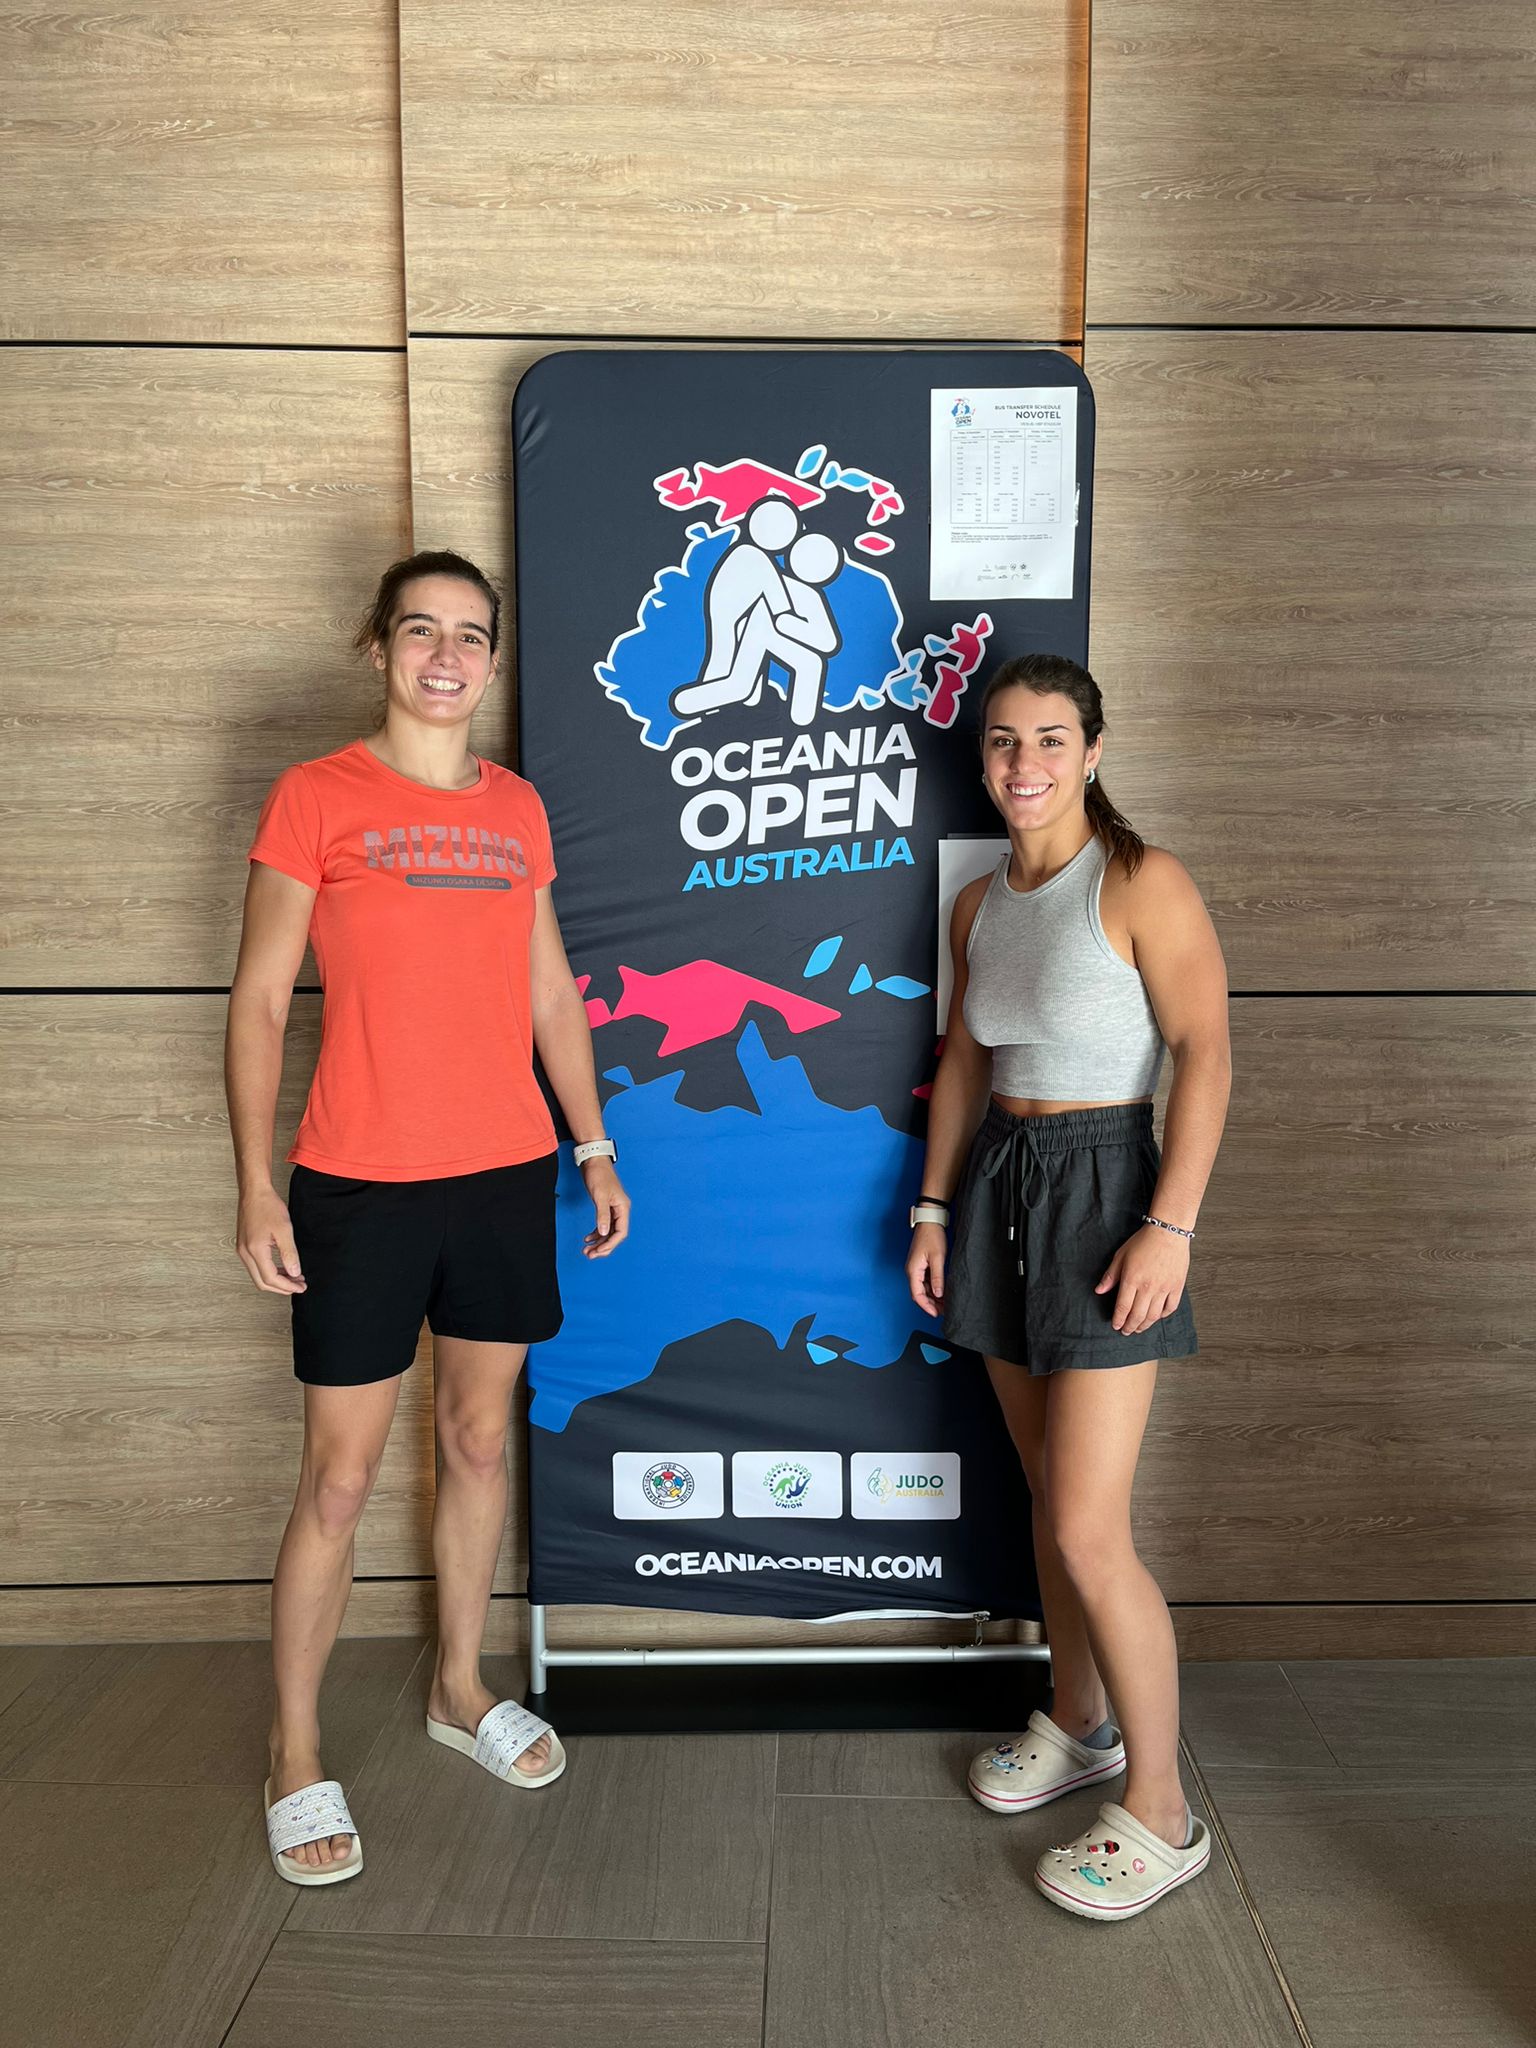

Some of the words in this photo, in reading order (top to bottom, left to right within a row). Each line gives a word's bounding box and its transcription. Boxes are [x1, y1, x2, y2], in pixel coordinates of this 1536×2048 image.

[1015, 411, 1061, 419] NOVOTEL
[670, 722, 917, 787] OCEANIA
[679, 767, 918, 852] OPEN
[363, 825, 528, 877] MIZUNO
[682, 836, 915, 892] AUSTRALIA
[413, 877, 446, 885] MIZUNO
[475, 878, 505, 887] DESIGN
[762, 1461, 790, 1487] OCEANIA
[793, 1463, 812, 1478] JUDO
[895, 1474, 944, 1489] JUDO
[775, 1500, 803, 1509] UNION
[895, 1489, 945, 1497] AUSTRALIA
[634, 1551, 942, 1580] OCEANIAOPEN.COM
